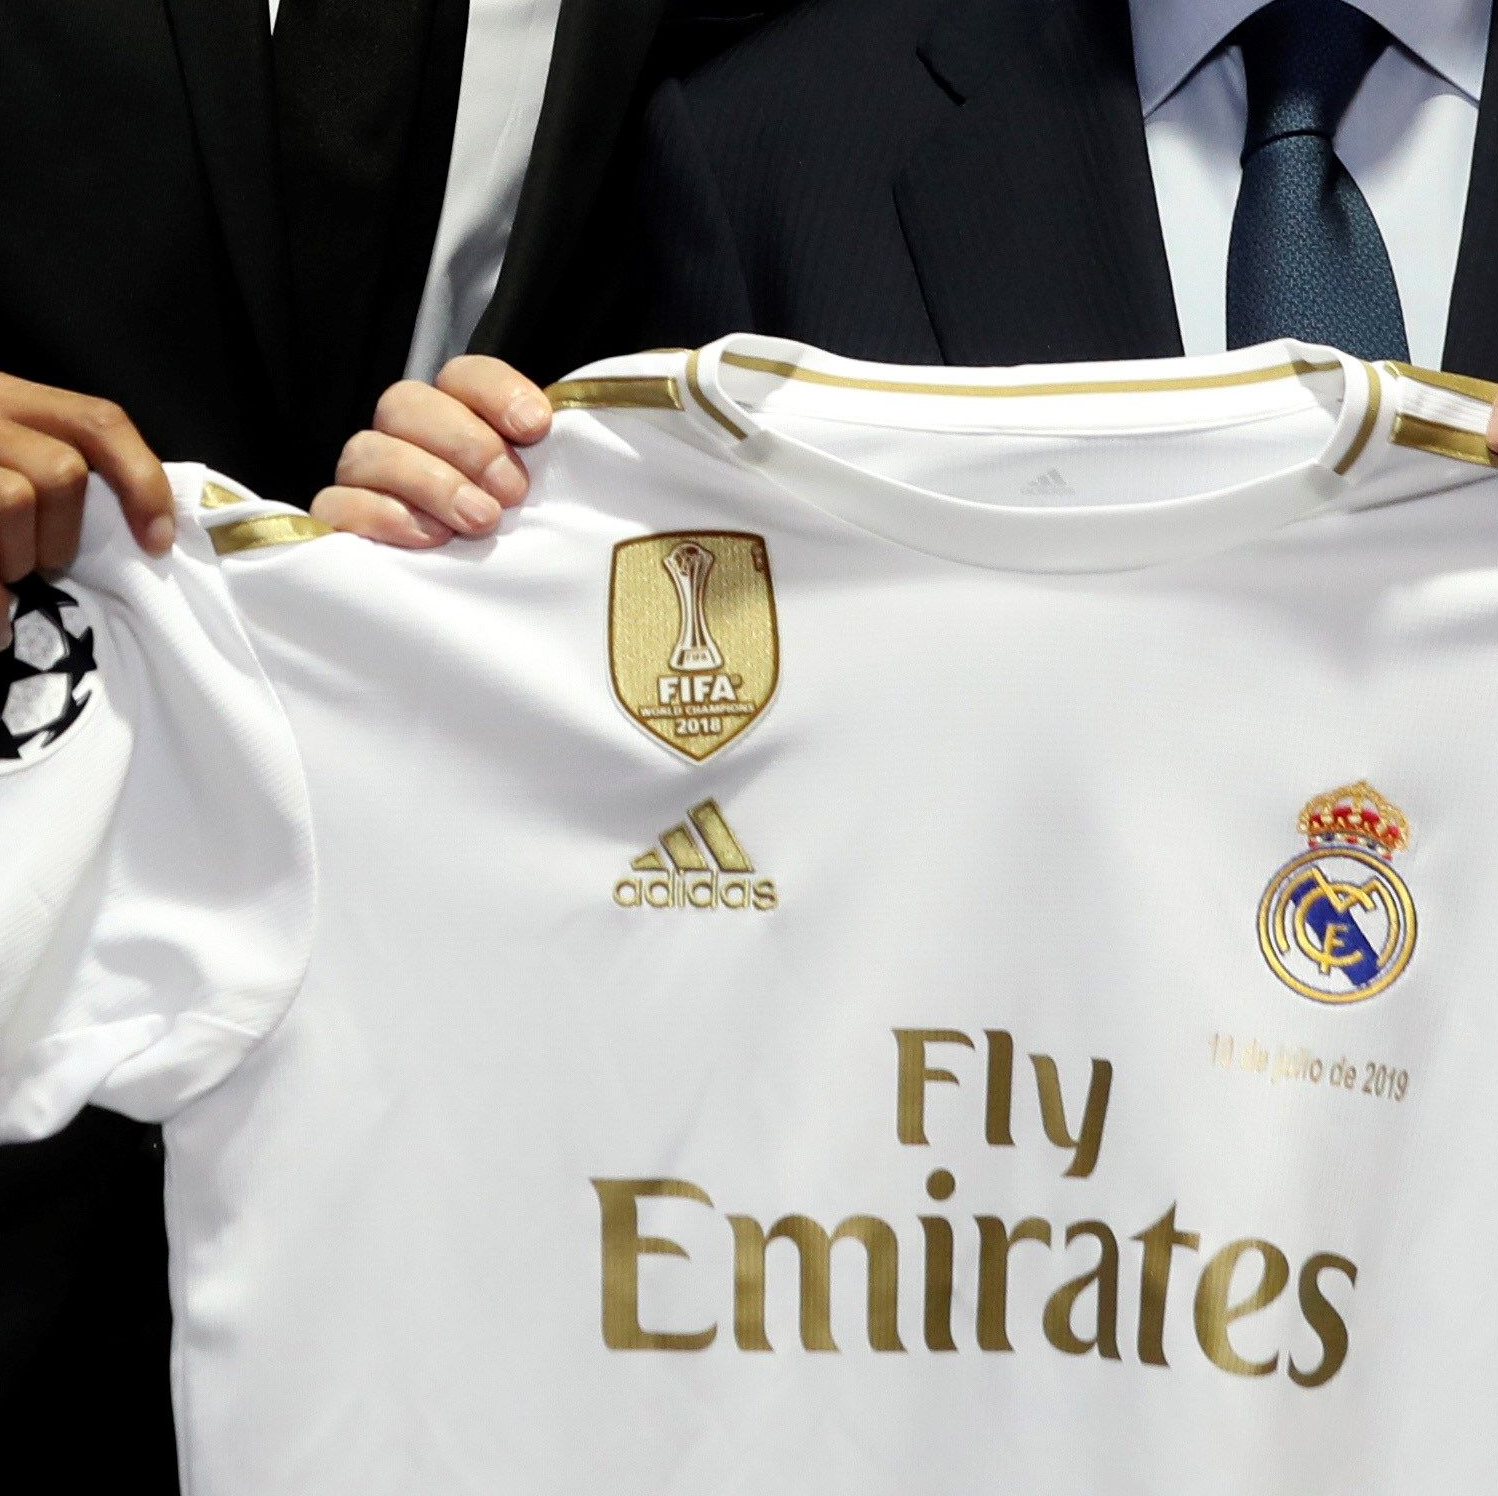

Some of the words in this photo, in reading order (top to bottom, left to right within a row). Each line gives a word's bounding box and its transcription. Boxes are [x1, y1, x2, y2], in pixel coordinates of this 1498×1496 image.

[659, 675, 737, 704] FIFA
[676, 717, 722, 736] 2018
[613, 868, 779, 911] adidas
[1330, 1055, 1357, 1089] de
[1362, 1061, 1409, 1102] 2019
[891, 1027, 1113, 1178] Fly
[589, 1168, 1359, 1388] Emirates
